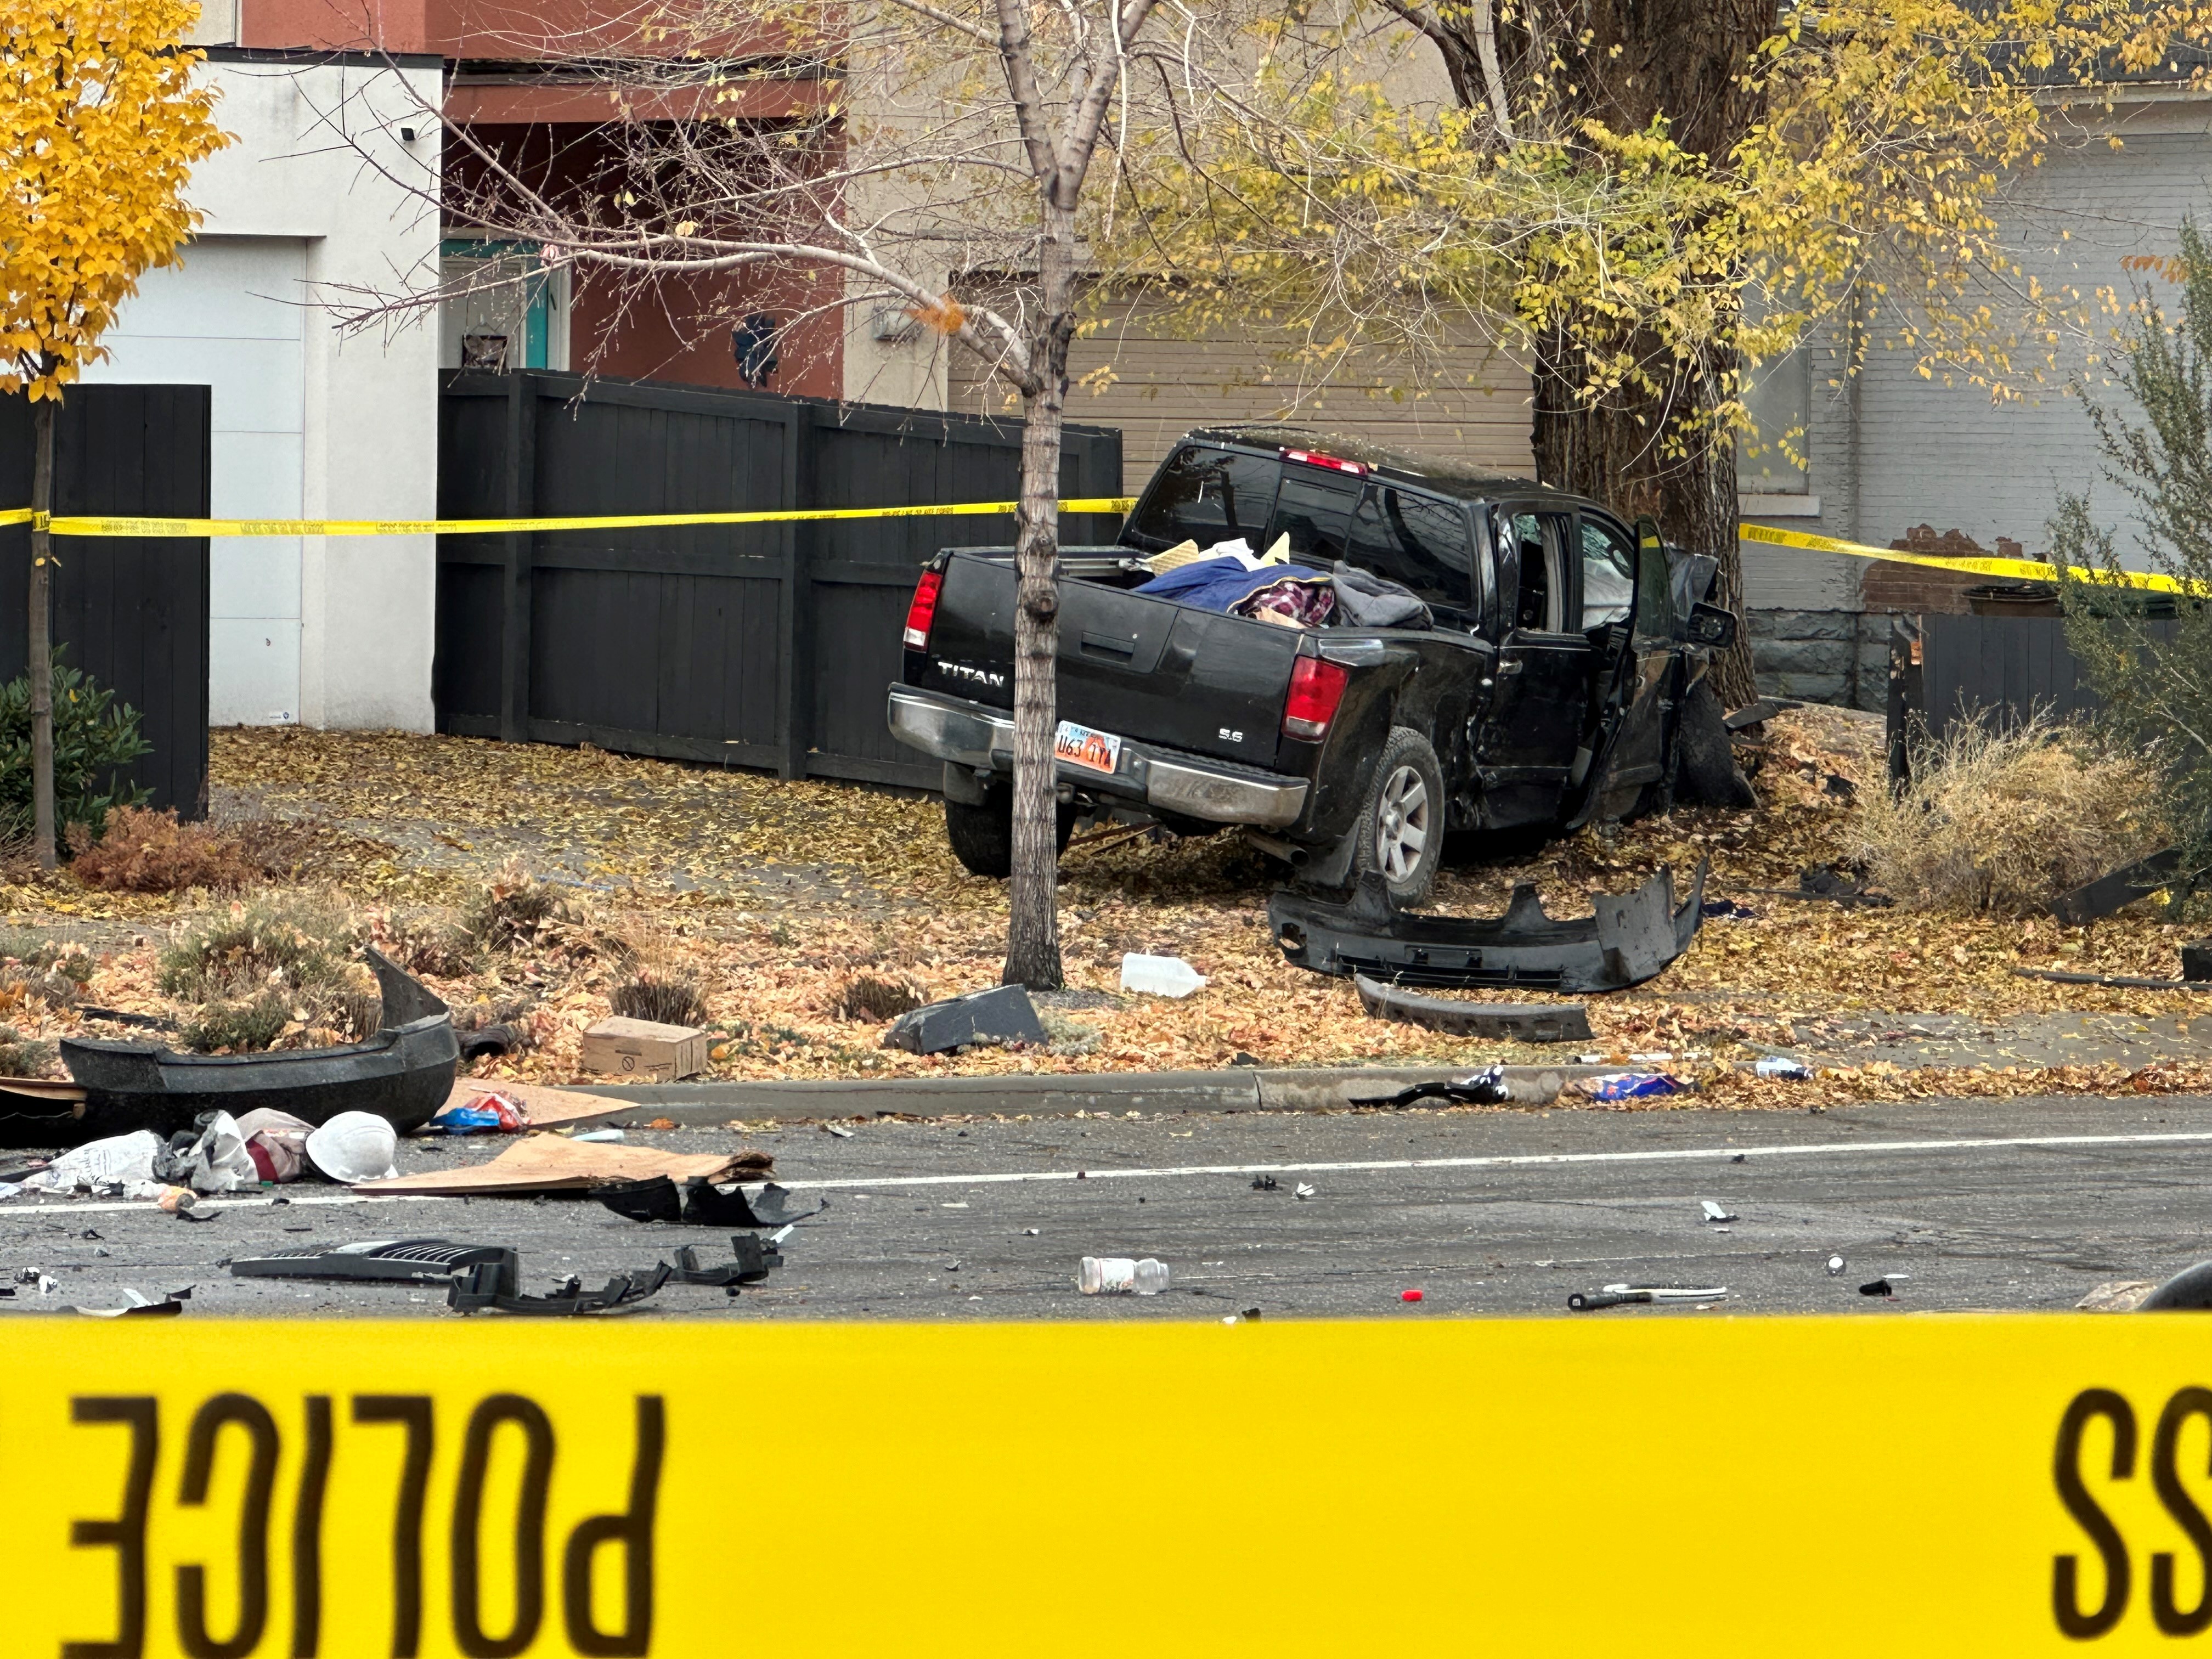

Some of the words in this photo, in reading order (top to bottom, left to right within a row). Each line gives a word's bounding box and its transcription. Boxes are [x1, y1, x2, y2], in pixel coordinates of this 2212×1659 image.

[938, 661, 1005, 687] TITAN
[1218, 728, 1243, 742] 5.6
[59, 1391, 666, 1659] POLICE
